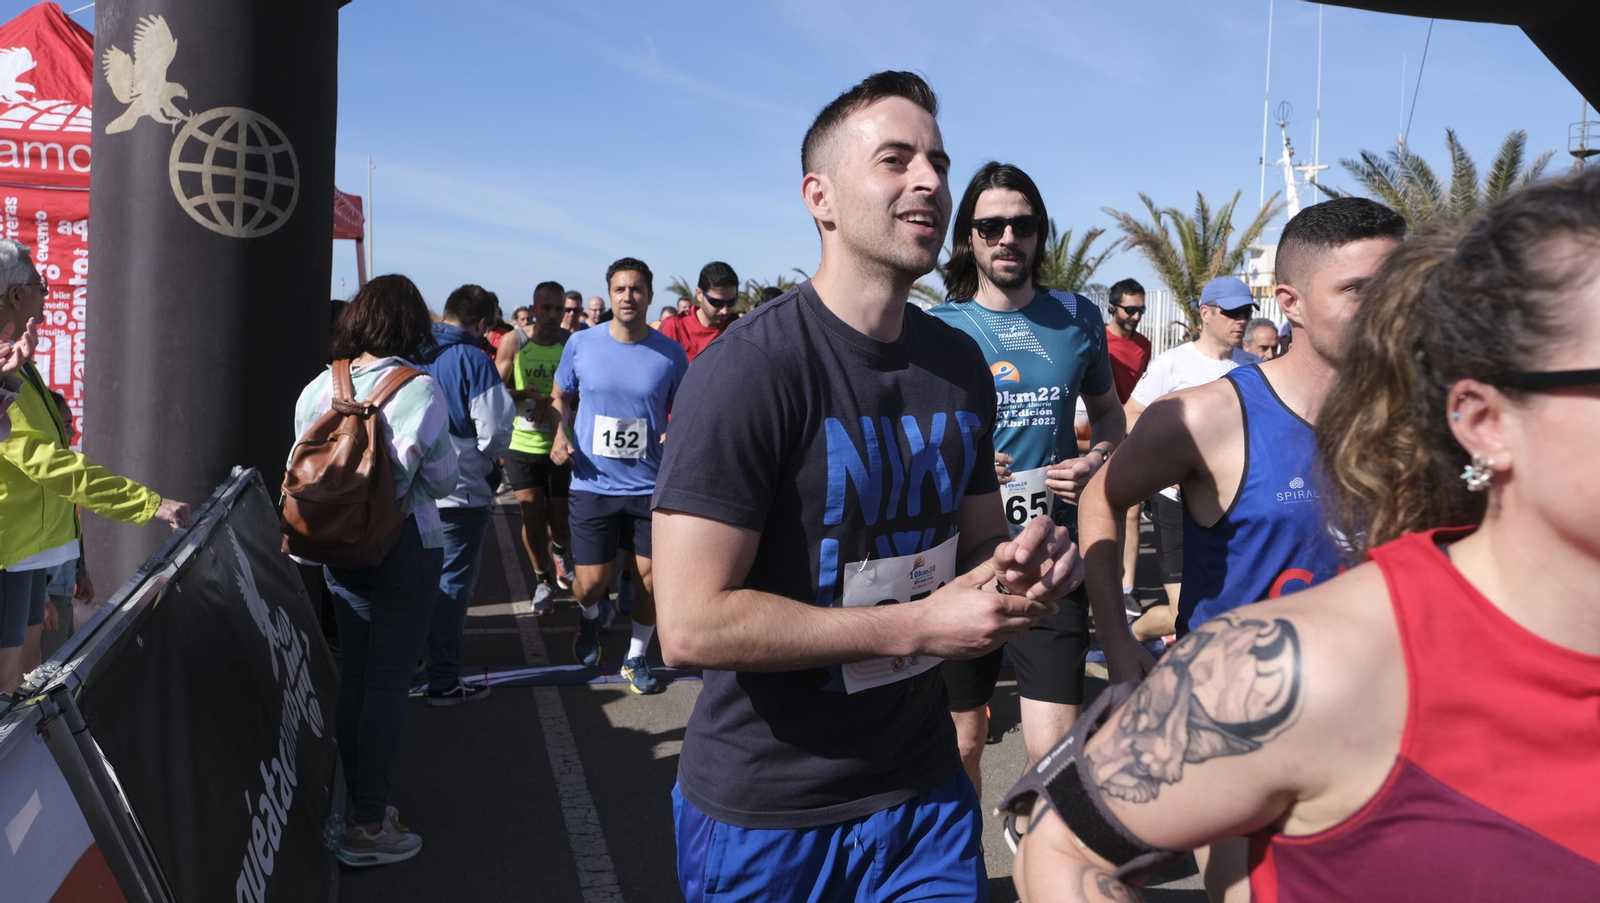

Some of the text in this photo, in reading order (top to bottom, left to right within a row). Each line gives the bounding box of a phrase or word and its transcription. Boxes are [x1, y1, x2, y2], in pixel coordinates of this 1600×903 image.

[53, 291, 70, 300] bike
[1011, 407, 1053, 417] Edición
[1003, 419, 1030, 428] Abril
[1032, 417, 1056, 426] 2022
[603, 430, 639, 448] 152
[1276, 490, 1320, 501] SPIRAL
[1005, 491, 1048, 524] 65
